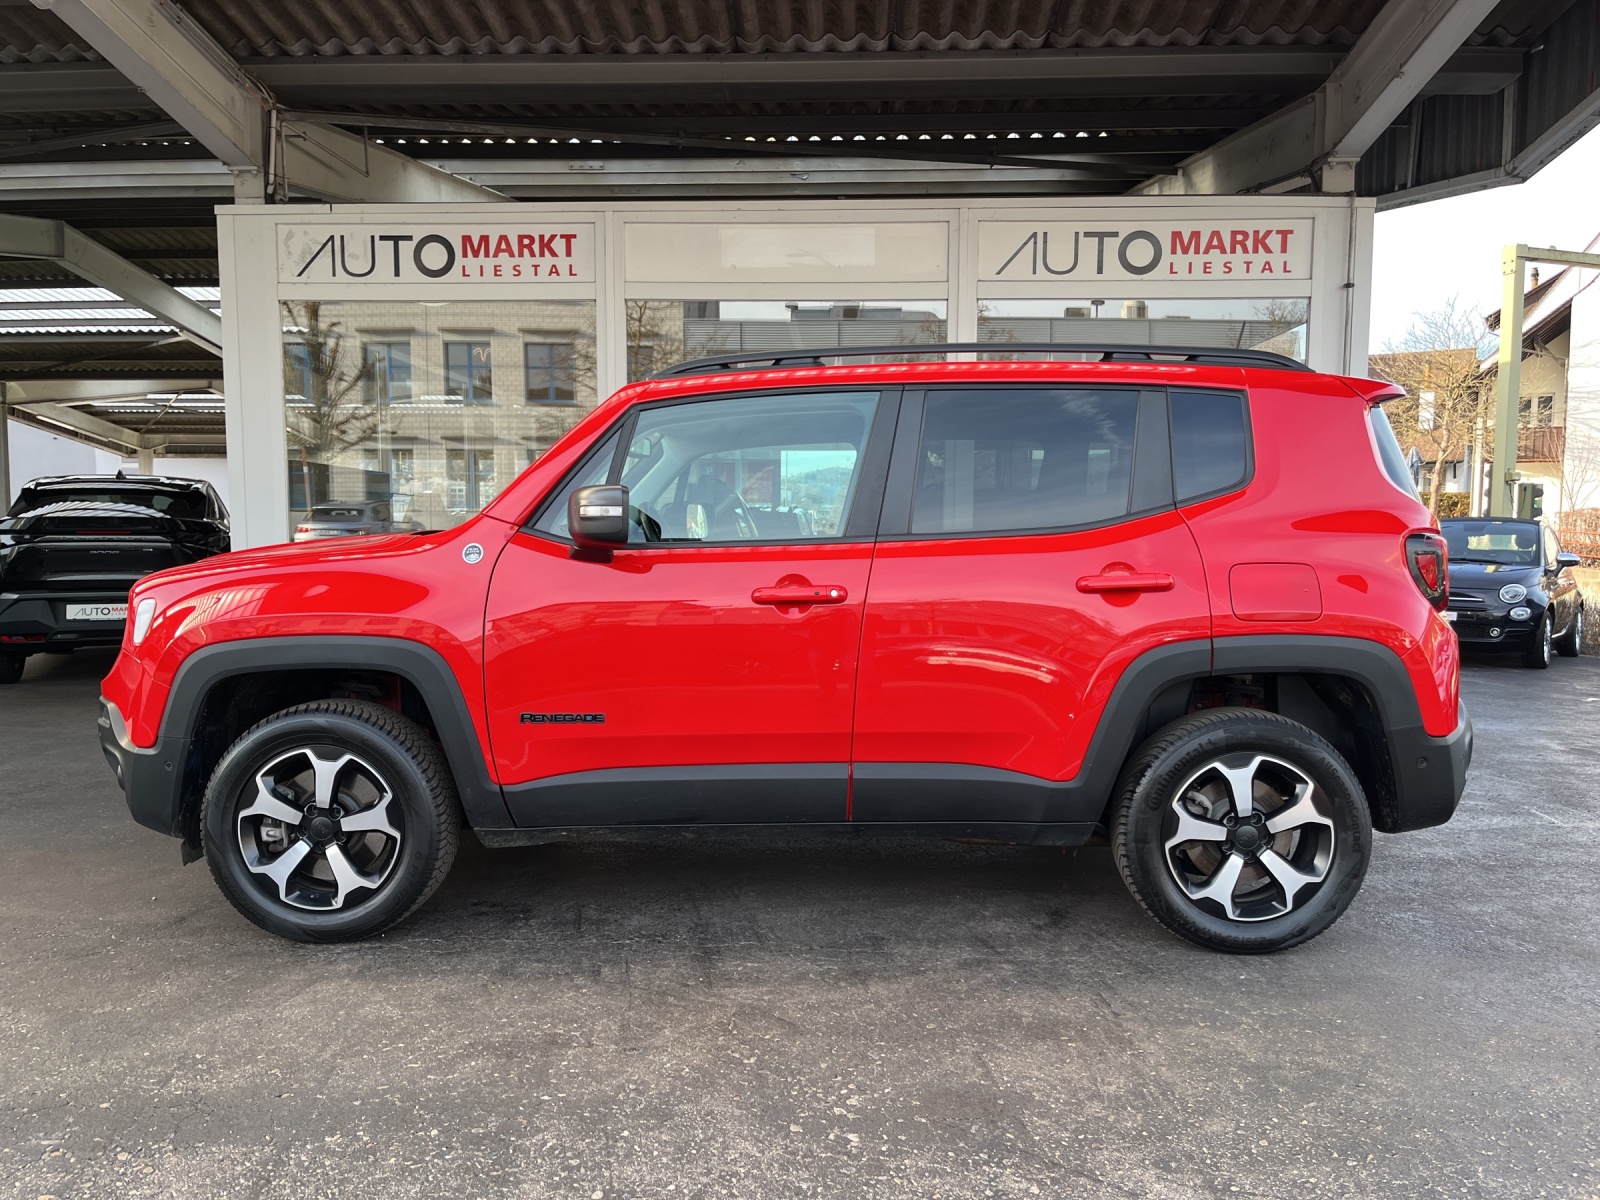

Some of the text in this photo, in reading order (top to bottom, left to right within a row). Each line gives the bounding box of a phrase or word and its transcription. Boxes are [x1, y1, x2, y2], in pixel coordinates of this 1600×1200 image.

[296, 233, 577, 278] AUTO MARKT
[994, 229, 1294, 276] AUTO MARKT
[461, 264, 578, 277] LIESTAL
[1169, 260, 1292, 275] LIESTAL
[74, 607, 110, 616] AUTO
[520, 713, 605, 723] RENEGADE
[1147, 742, 1206, 812] Continental
